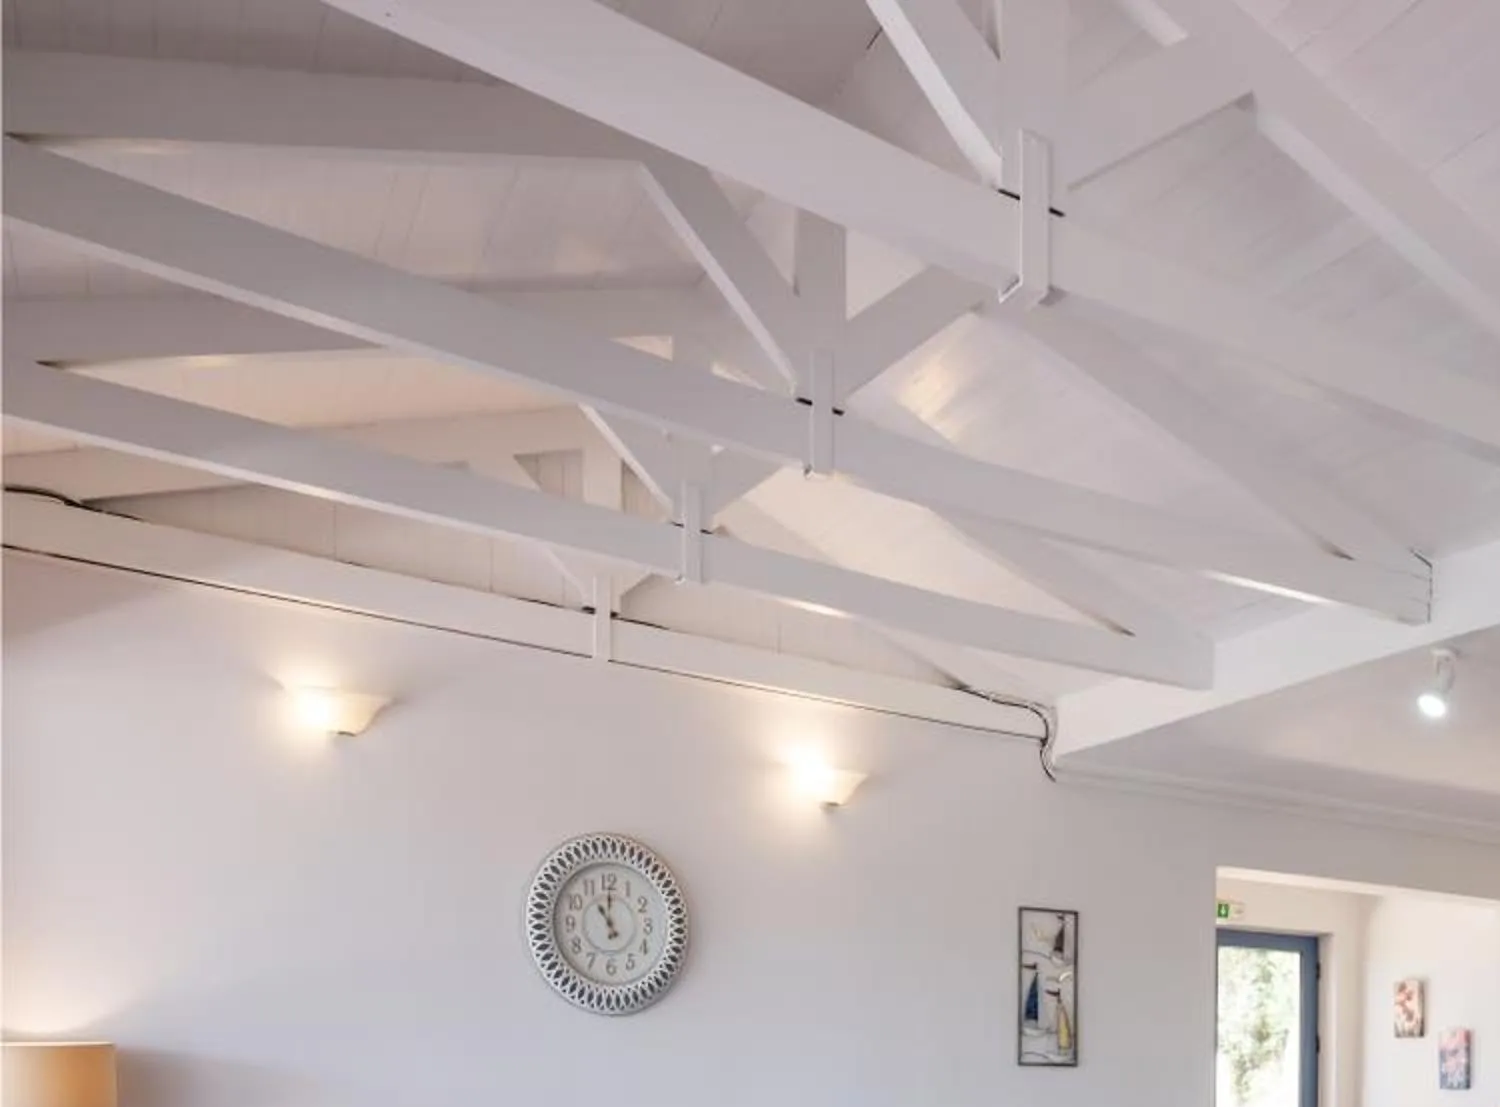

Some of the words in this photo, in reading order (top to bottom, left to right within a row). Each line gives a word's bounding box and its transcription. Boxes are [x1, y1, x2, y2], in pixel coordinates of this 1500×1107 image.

[583, 880, 595, 897] 11
[601, 873, 617, 891] 12
[625, 880, 630, 897] 1
[569, 894, 583, 911] 10
[637, 896, 647, 913] 2
[565, 916, 575, 933] 9
[643, 918, 653, 936] 3
[571, 935, 581, 954] 8
[586, 952, 597, 970] 7
[606, 957, 616, 976] 6
[625, 953, 635, 970] 5
